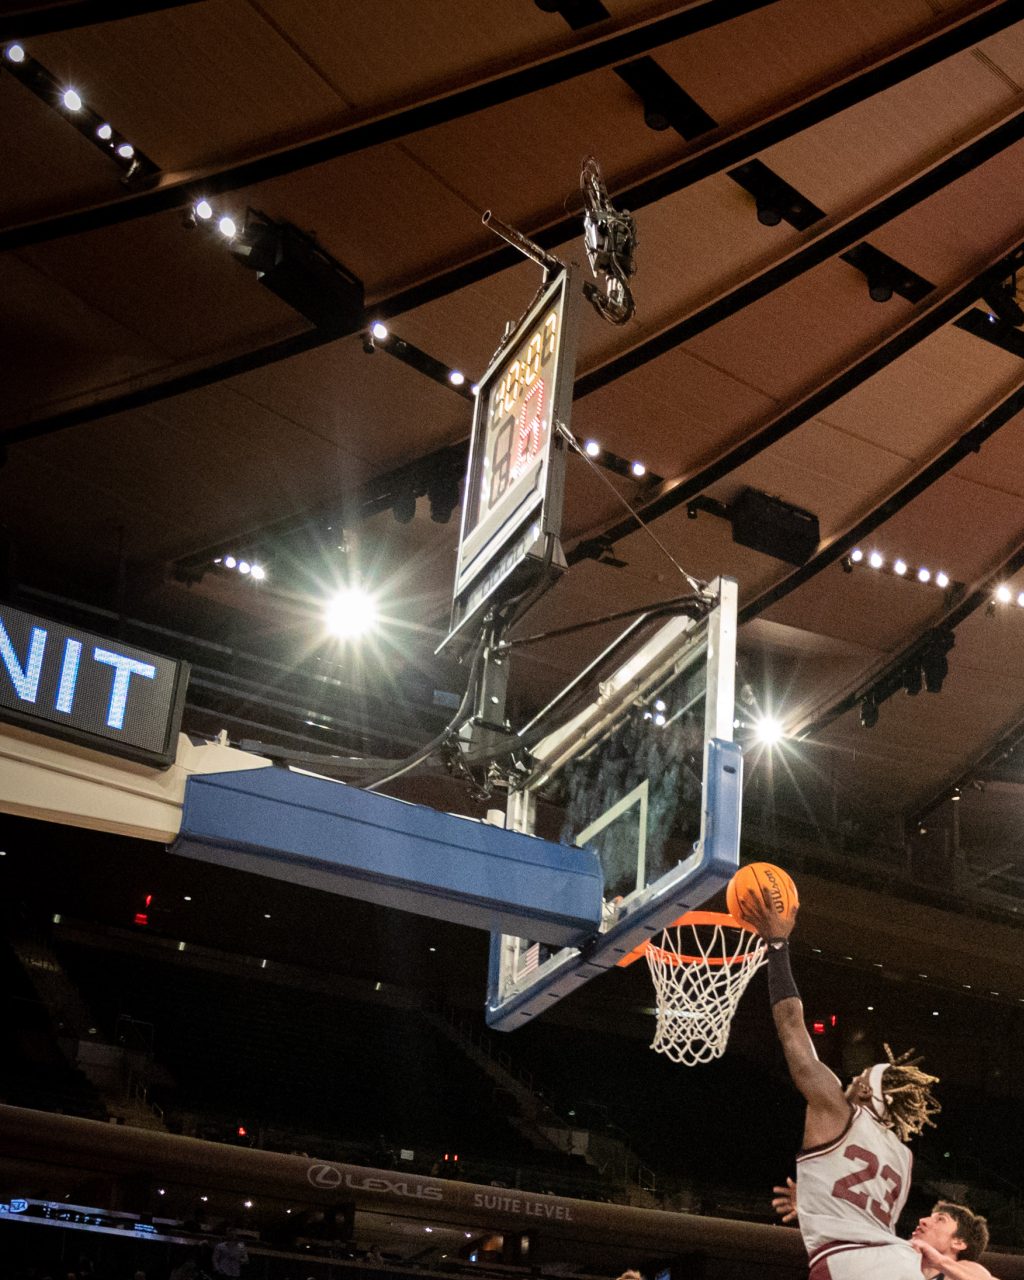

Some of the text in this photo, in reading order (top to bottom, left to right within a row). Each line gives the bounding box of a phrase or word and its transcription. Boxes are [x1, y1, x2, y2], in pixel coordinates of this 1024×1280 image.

[0, 615, 156, 730] NIT
[345, 1174, 573, 1222] LEXUS SUITE LEVEL
[831, 1144, 903, 1228] 23
